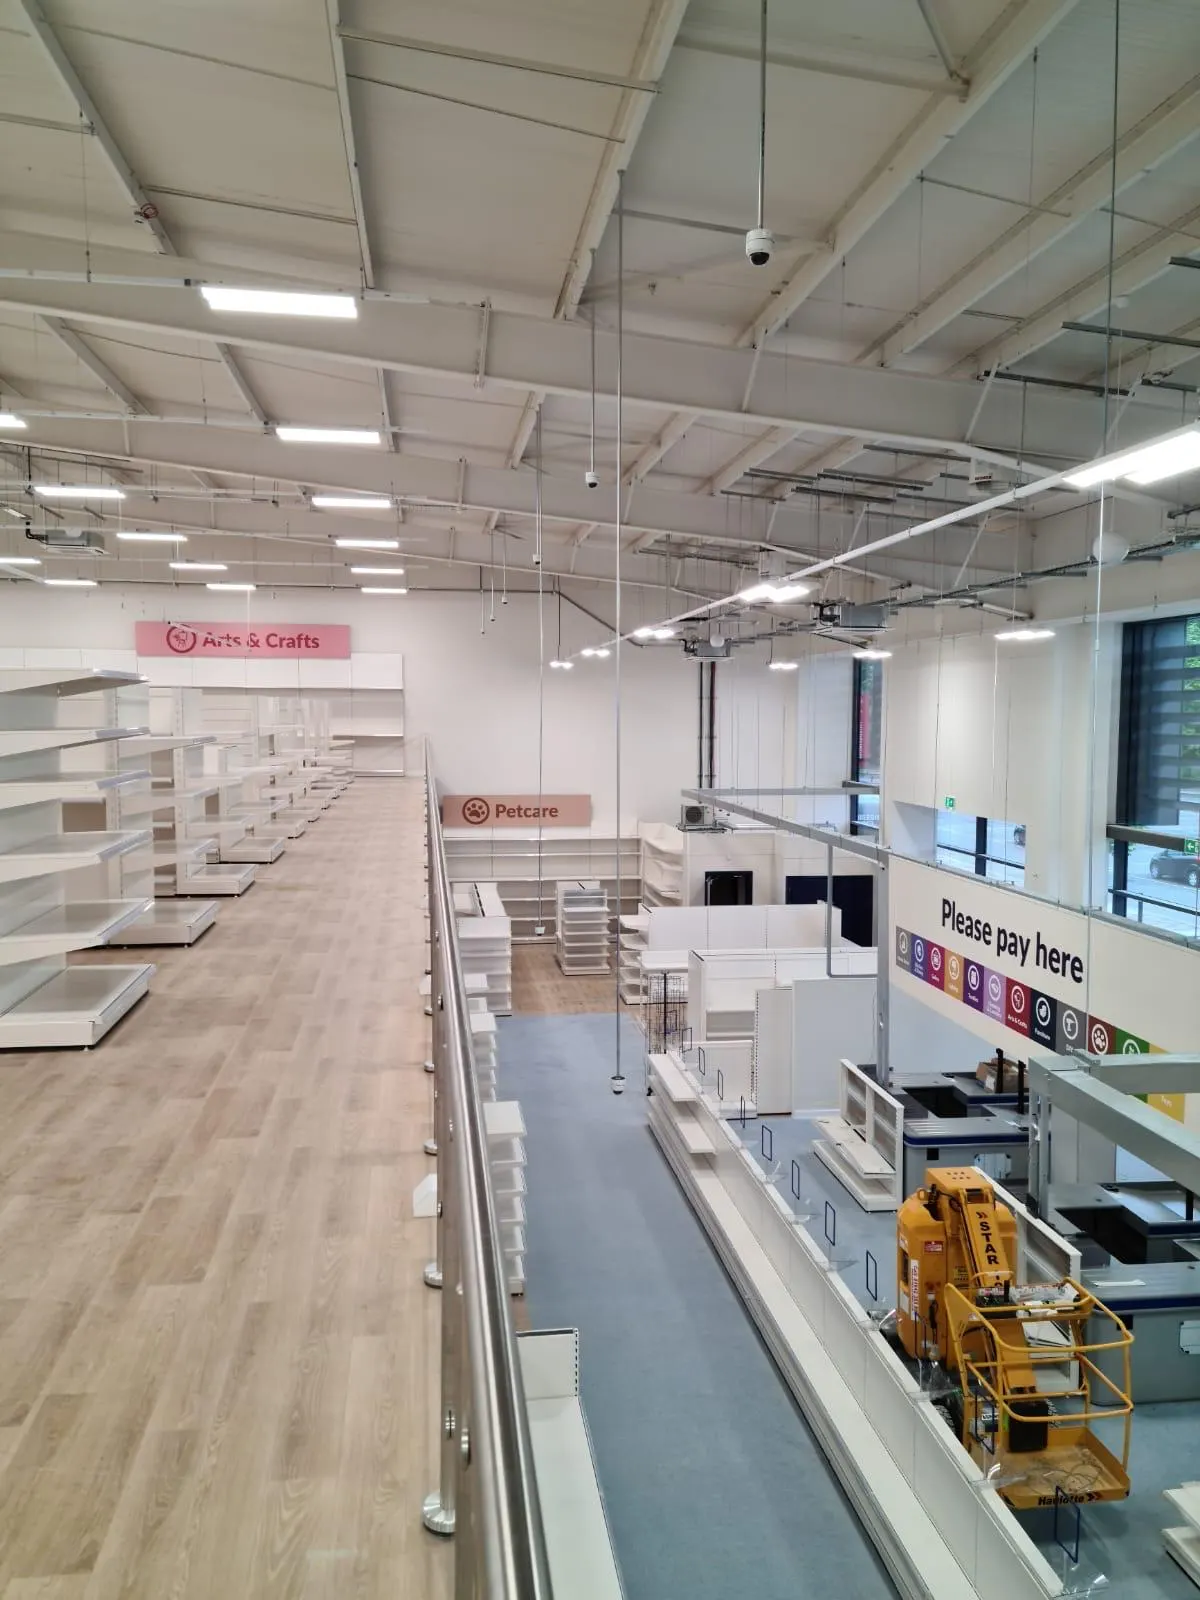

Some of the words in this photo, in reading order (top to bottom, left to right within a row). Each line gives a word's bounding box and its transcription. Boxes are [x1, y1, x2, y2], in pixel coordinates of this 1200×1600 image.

[203, 632, 241, 647] Arts
[247, 633, 260, 648] &
[266, 633, 320, 649] Crafts
[495, 804, 559, 818] Petcare
[942, 898, 992, 945] Please
[997, 927, 1031, 967] pay
[1035, 931, 1084, 983] here
[979, 1221, 999, 1265] STAR
